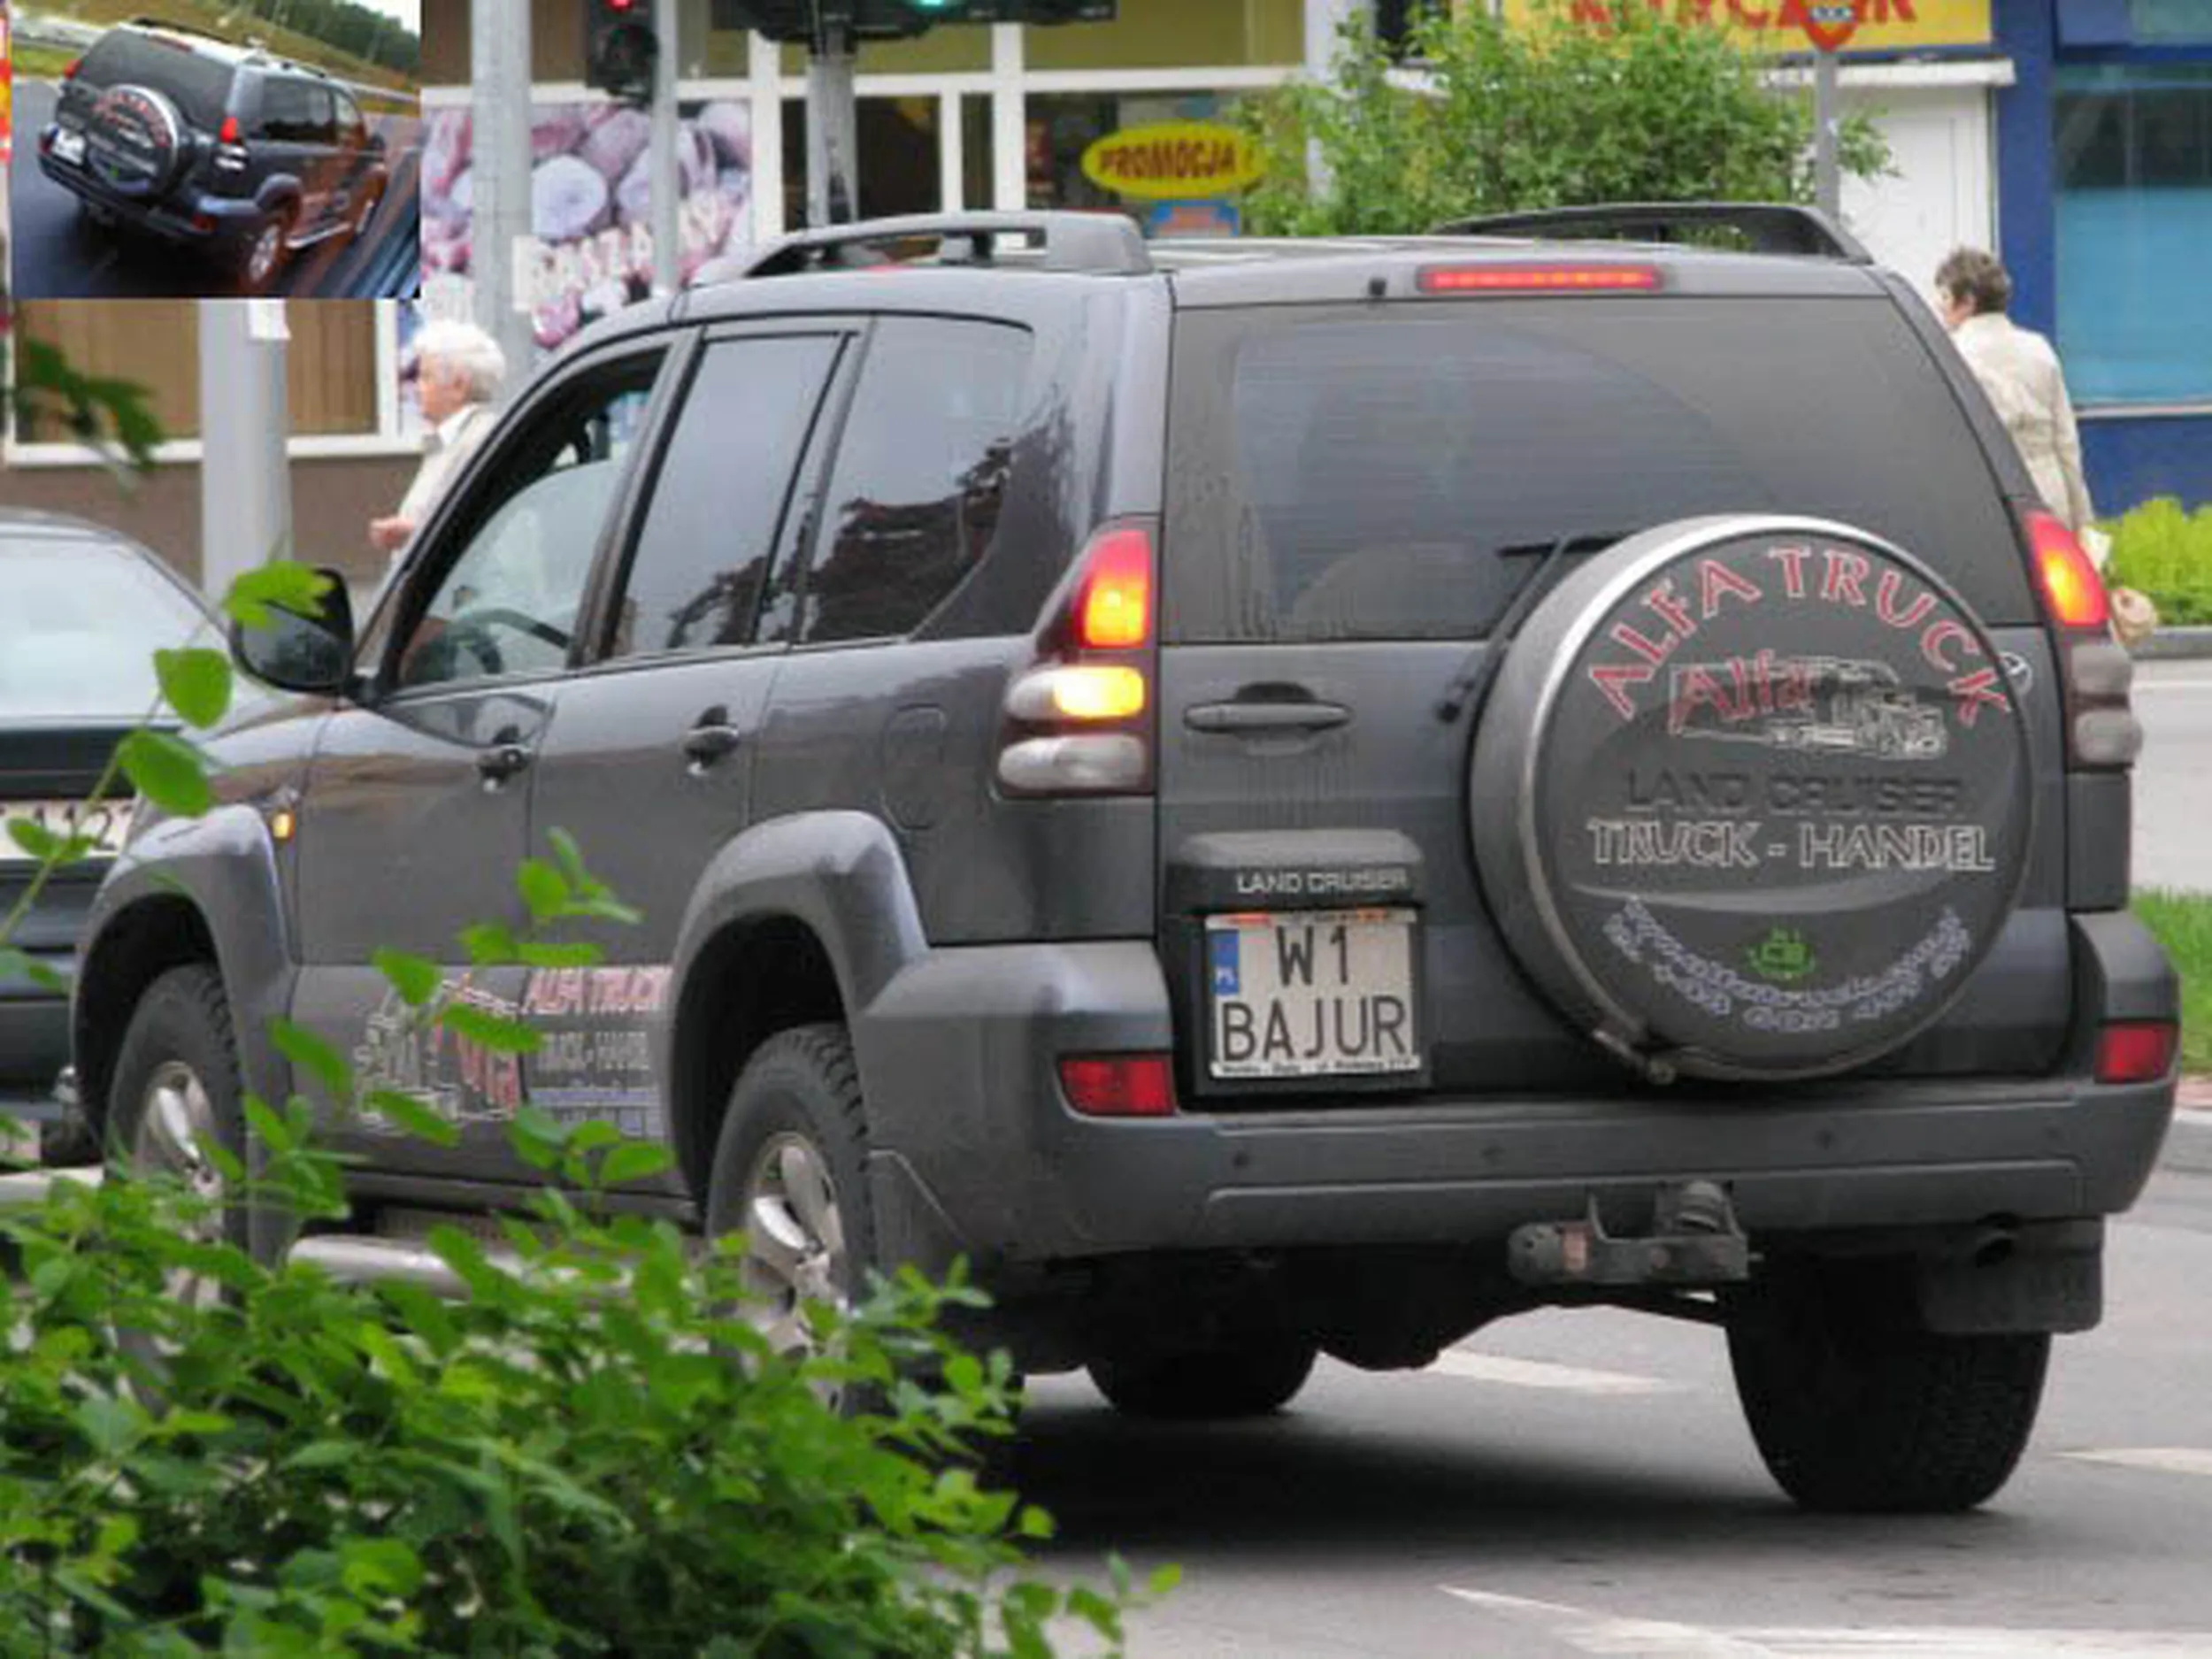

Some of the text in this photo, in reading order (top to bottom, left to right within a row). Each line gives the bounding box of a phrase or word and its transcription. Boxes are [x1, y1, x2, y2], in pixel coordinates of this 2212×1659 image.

[1099, 138, 1236, 179] PROMOCJA
[1591, 545, 2011, 726] ALFA TRUCK
[1626, 770, 1749, 813] LAND
[1586, 816, 1763, 867] TRUCK
[1799, 821, 1995, 871] HANDEL
[1236, 868, 1409, 894] LAND CRUISER
[1221, 995, 1407, 1063] BAJUR
